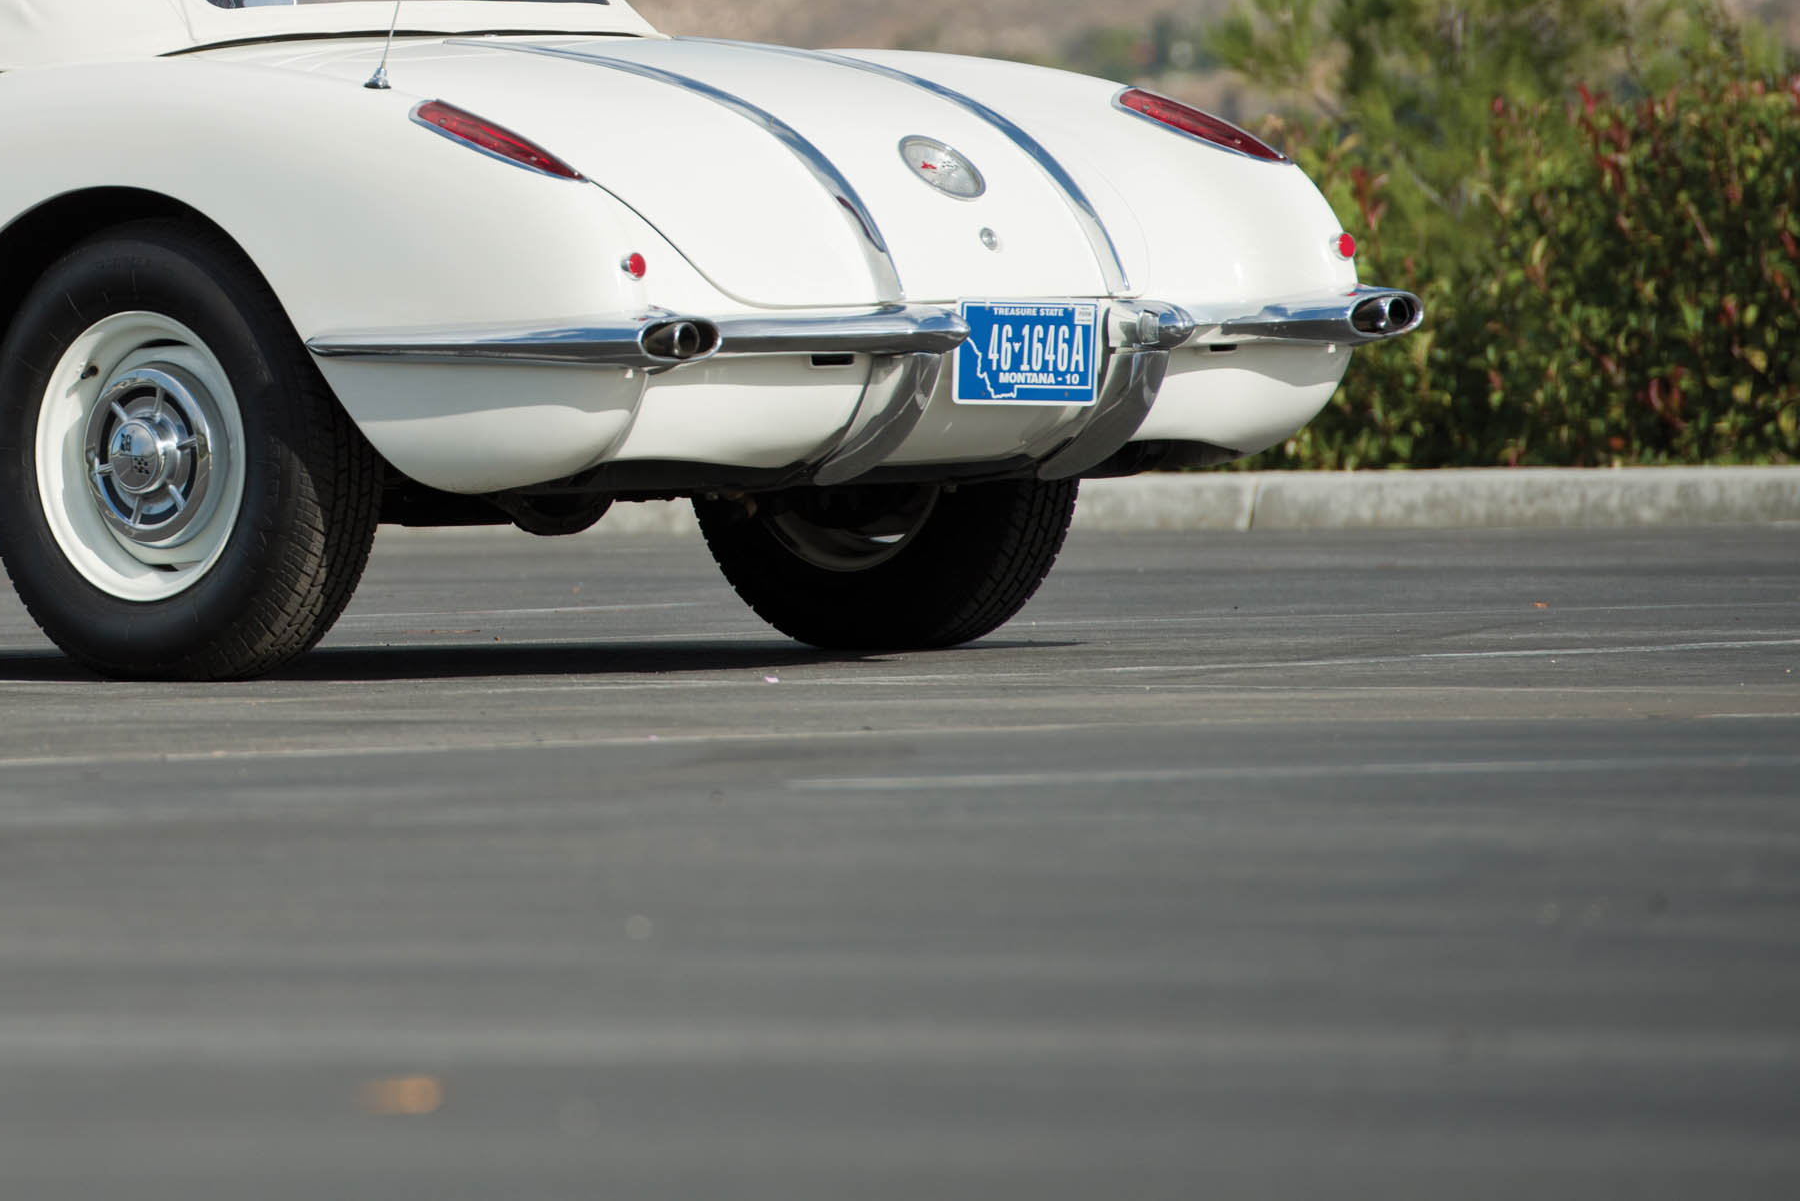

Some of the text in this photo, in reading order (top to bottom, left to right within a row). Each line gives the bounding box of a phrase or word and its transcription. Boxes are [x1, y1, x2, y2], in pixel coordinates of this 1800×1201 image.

[993, 306, 1037, 317] TREASURE
[1039, 307, 1065, 317] STATE
[998, 371, 1056, 385] MONTANA
[1065, 373, 1080, 385] 10
